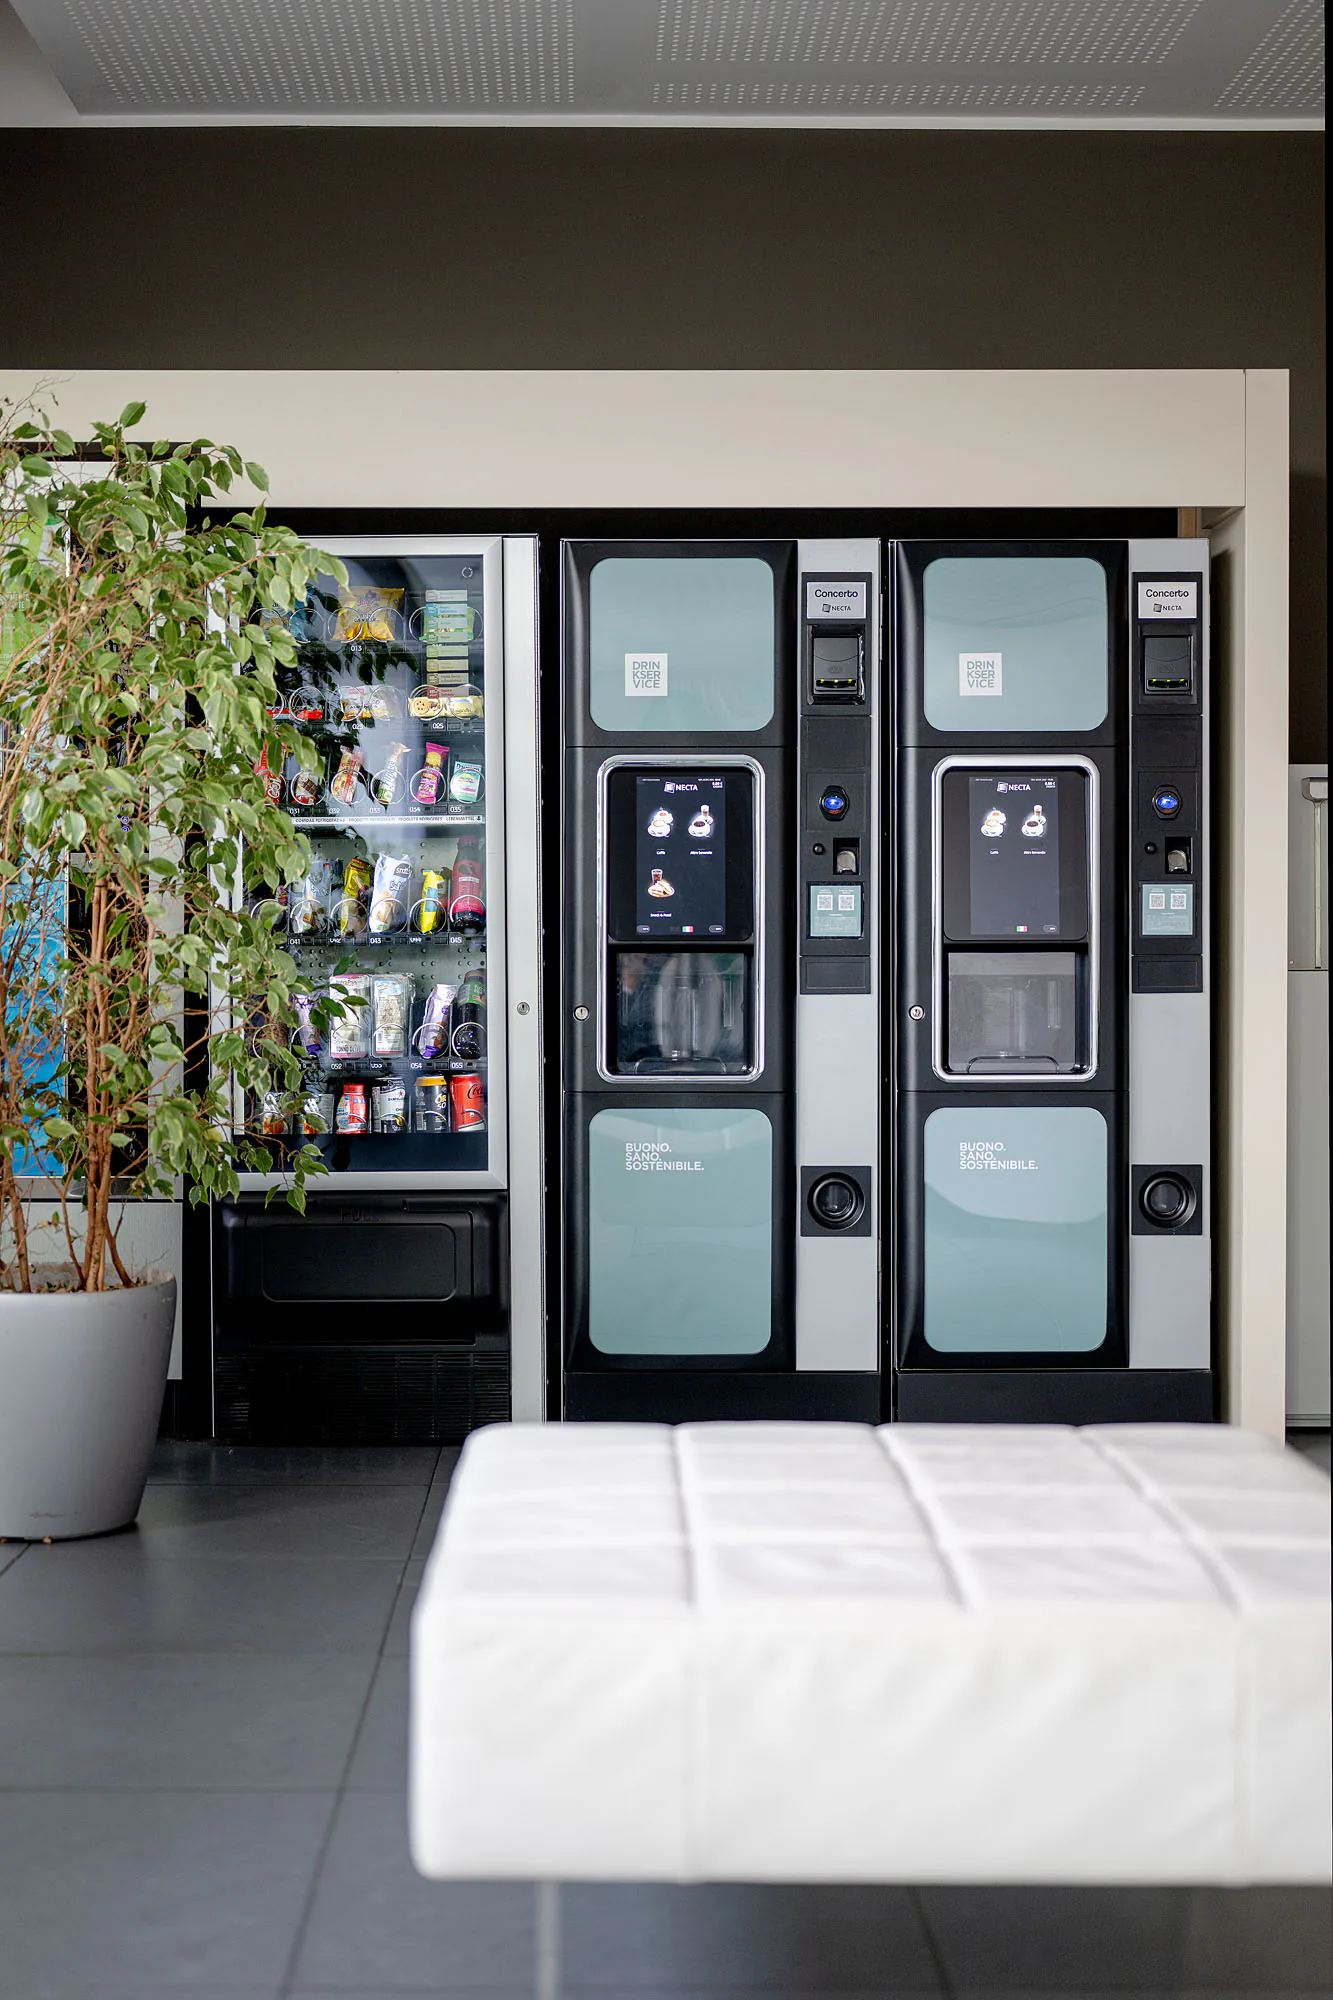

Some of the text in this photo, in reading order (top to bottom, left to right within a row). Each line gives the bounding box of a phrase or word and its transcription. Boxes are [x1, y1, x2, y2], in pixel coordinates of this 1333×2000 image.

[815, 589, 858, 598] Concerto
[1146, 588, 1189, 598] Concerto
[632, 661, 660, 670] DRIN
[967, 660, 994, 669] DRIN
[632, 670, 660, 679] KSER
[967, 670, 995, 679] KSER
[632, 680, 660, 688] VICE
[968, 680, 994, 688] VICE
[626, 1143, 672, 1152] BUONO.
[960, 1142, 1006, 1152] BUONO.
[626, 1152, 662, 1161] SANO.
[960, 1152, 996, 1160] SANO.
[626, 1161, 704, 1170] SOSTENIBILE.
[960, 1160, 1038, 1170] SOSTENIBILE.
